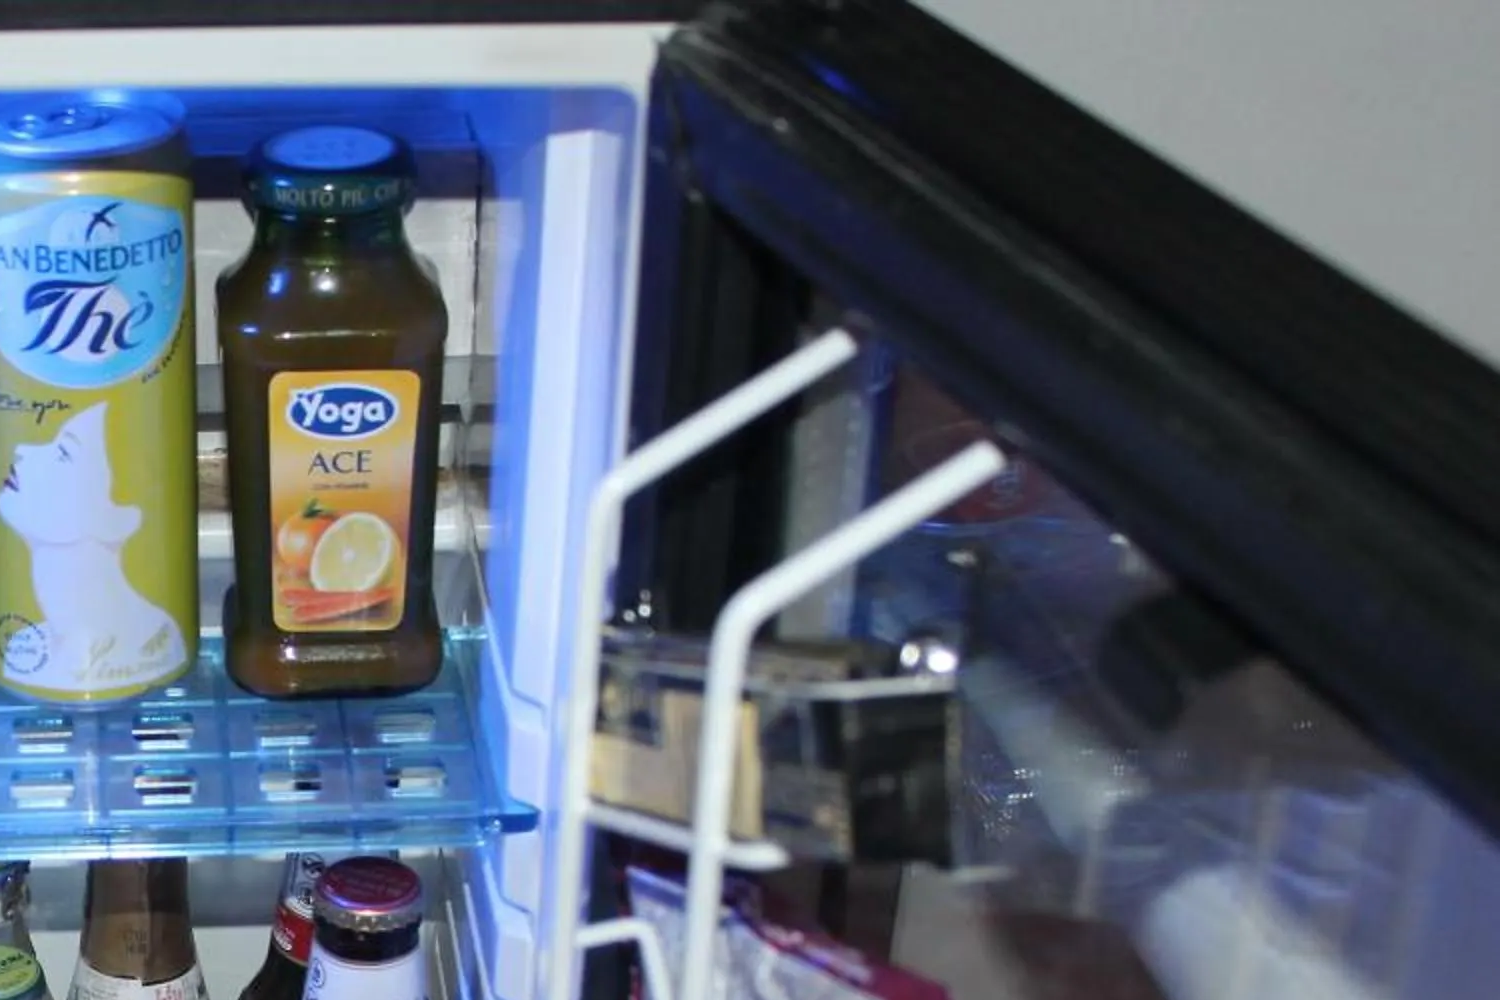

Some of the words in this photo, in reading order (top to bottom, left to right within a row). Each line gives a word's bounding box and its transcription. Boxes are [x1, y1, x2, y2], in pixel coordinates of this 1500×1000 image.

[34, 229, 183, 275] BENEDETTO
[294, 389, 385, 433] Yoga
[307, 450, 373, 476] ACE
